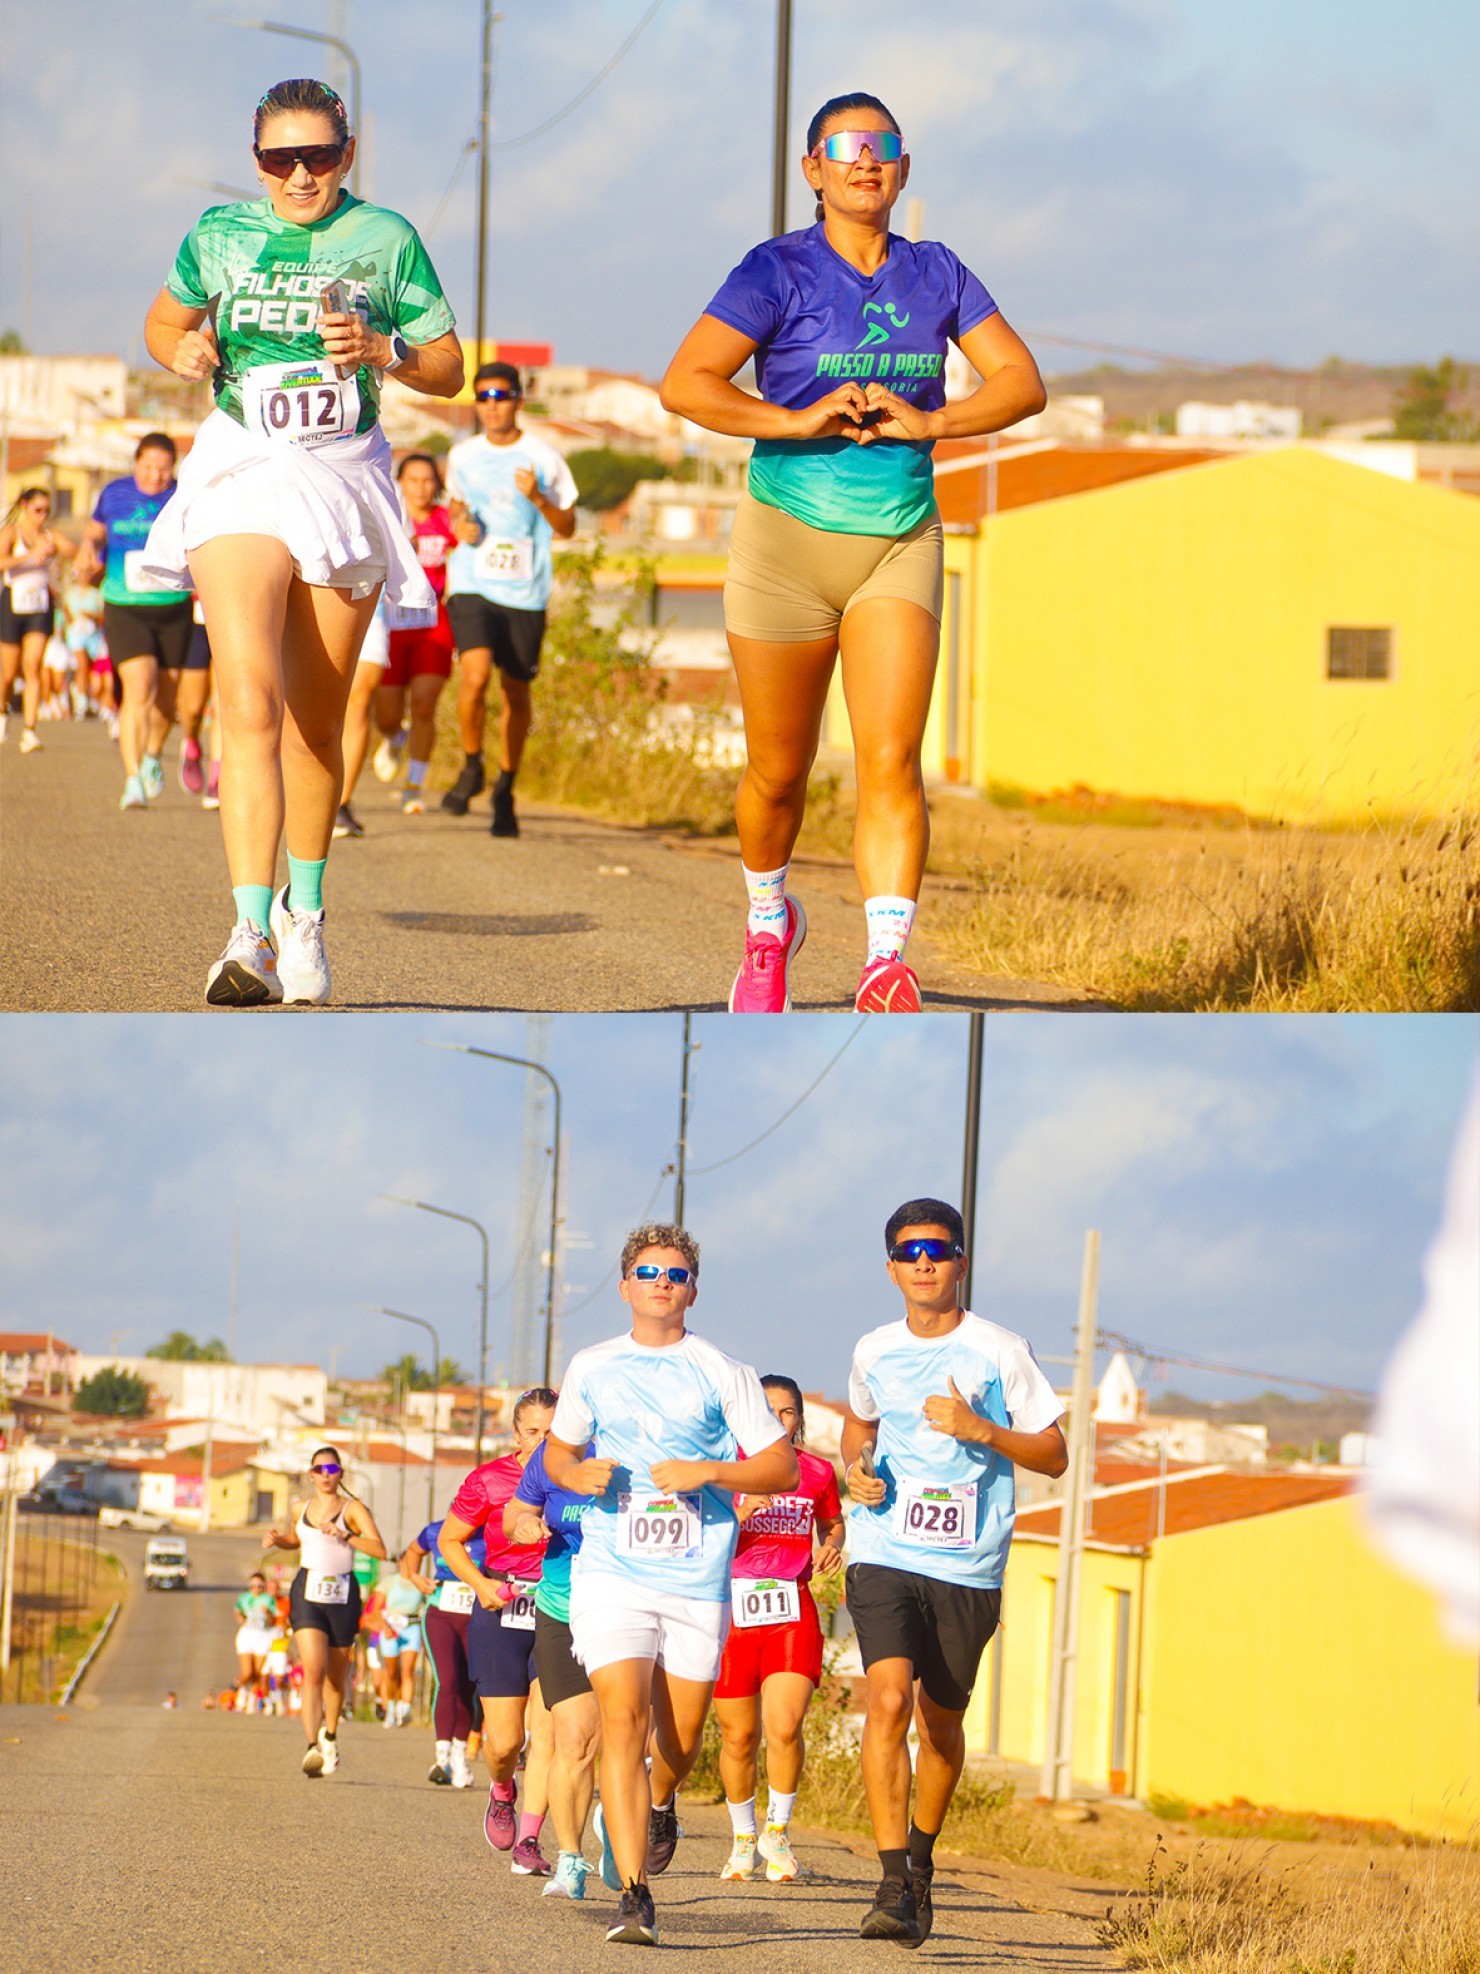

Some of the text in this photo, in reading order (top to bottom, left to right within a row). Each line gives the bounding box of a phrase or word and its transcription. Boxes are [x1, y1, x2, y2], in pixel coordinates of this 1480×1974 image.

[271, 261, 338, 274] EQUIPE
[816, 353, 942, 377] PASSO A PASSO
[269, 389, 336, 429] 012
[488, 552, 519, 569] 028
[910, 1503, 958, 1533] 028
[634, 1517, 683, 1544] 099
[317, 1582, 342, 1597] 134
[747, 1592, 786, 1615] 011
